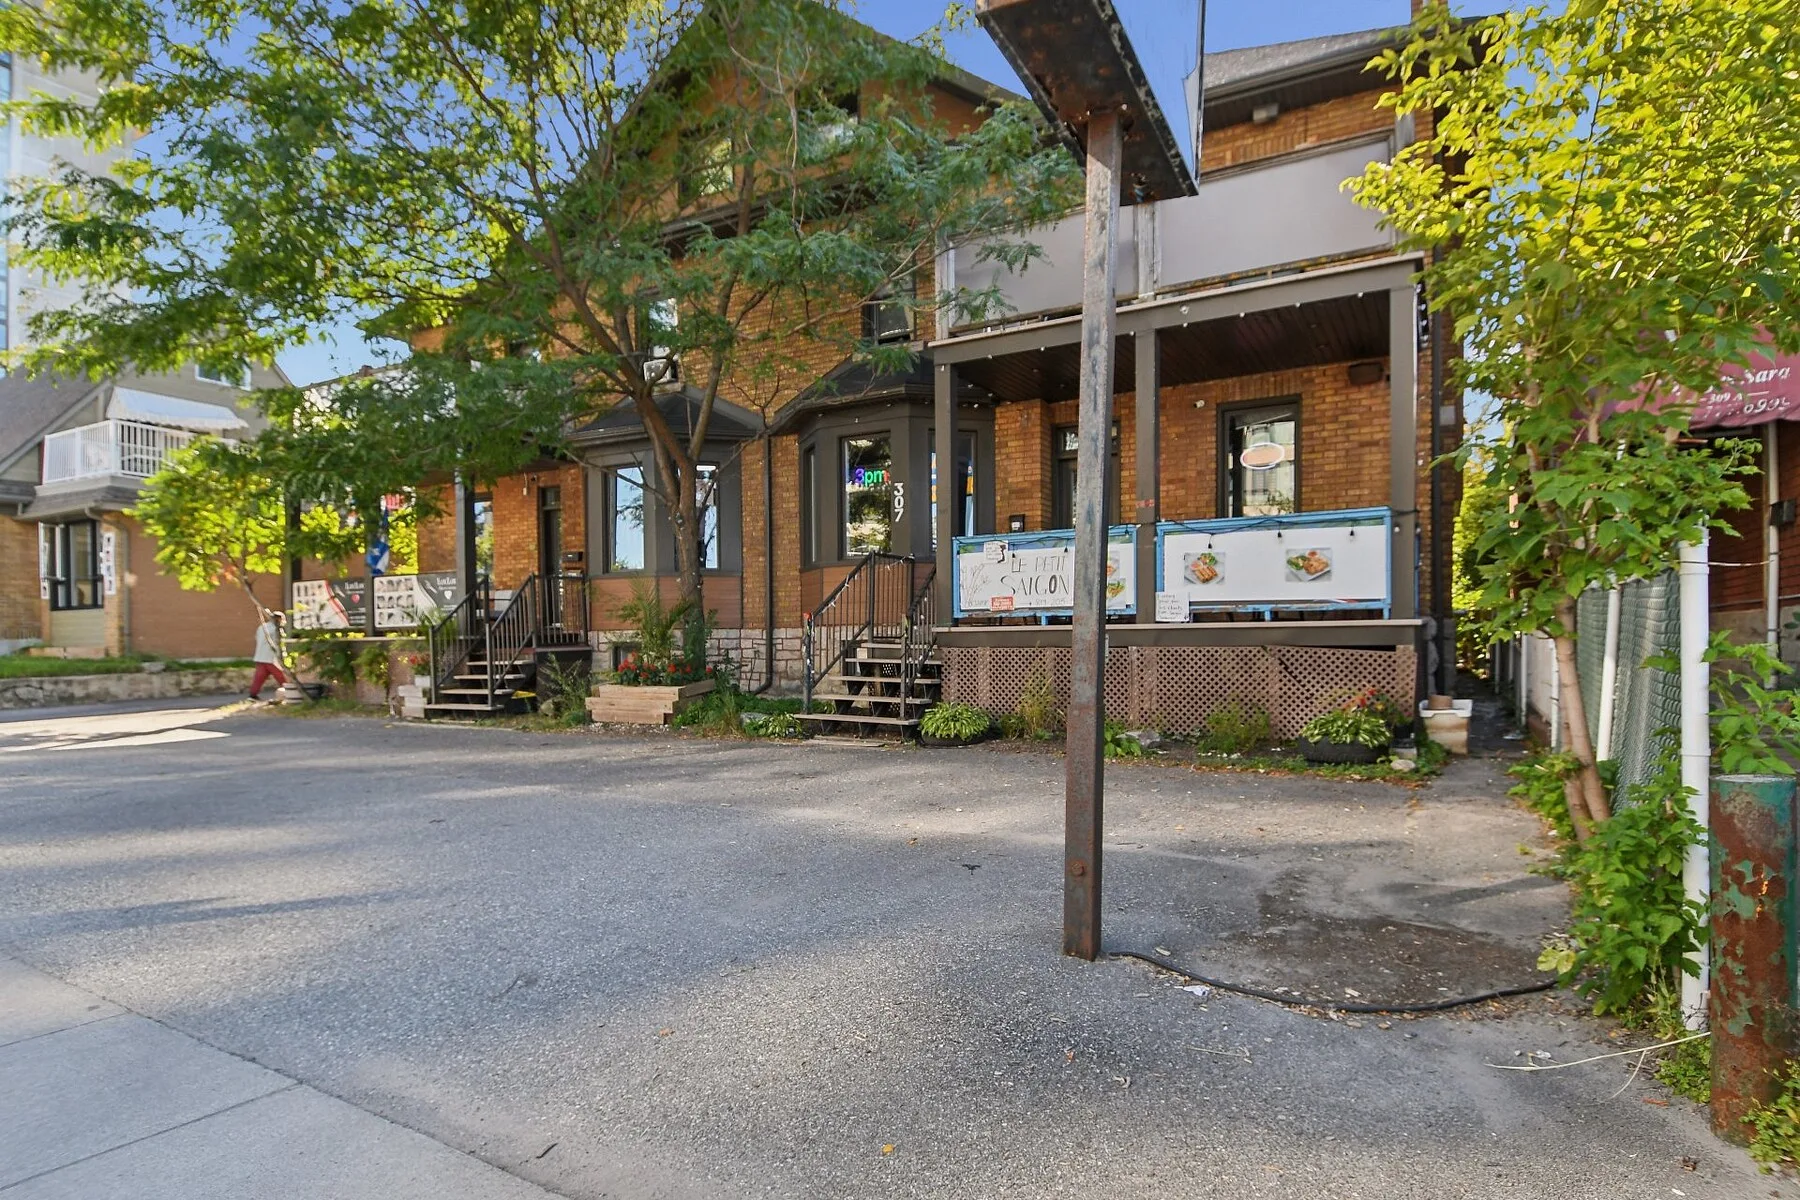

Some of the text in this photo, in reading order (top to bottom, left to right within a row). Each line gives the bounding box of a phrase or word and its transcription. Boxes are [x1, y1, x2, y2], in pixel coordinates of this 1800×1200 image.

[894, 483, 904, 522] 307
[1035, 557, 1066, 572] PETIT
[1000, 575, 1070, 595] SAIGON
